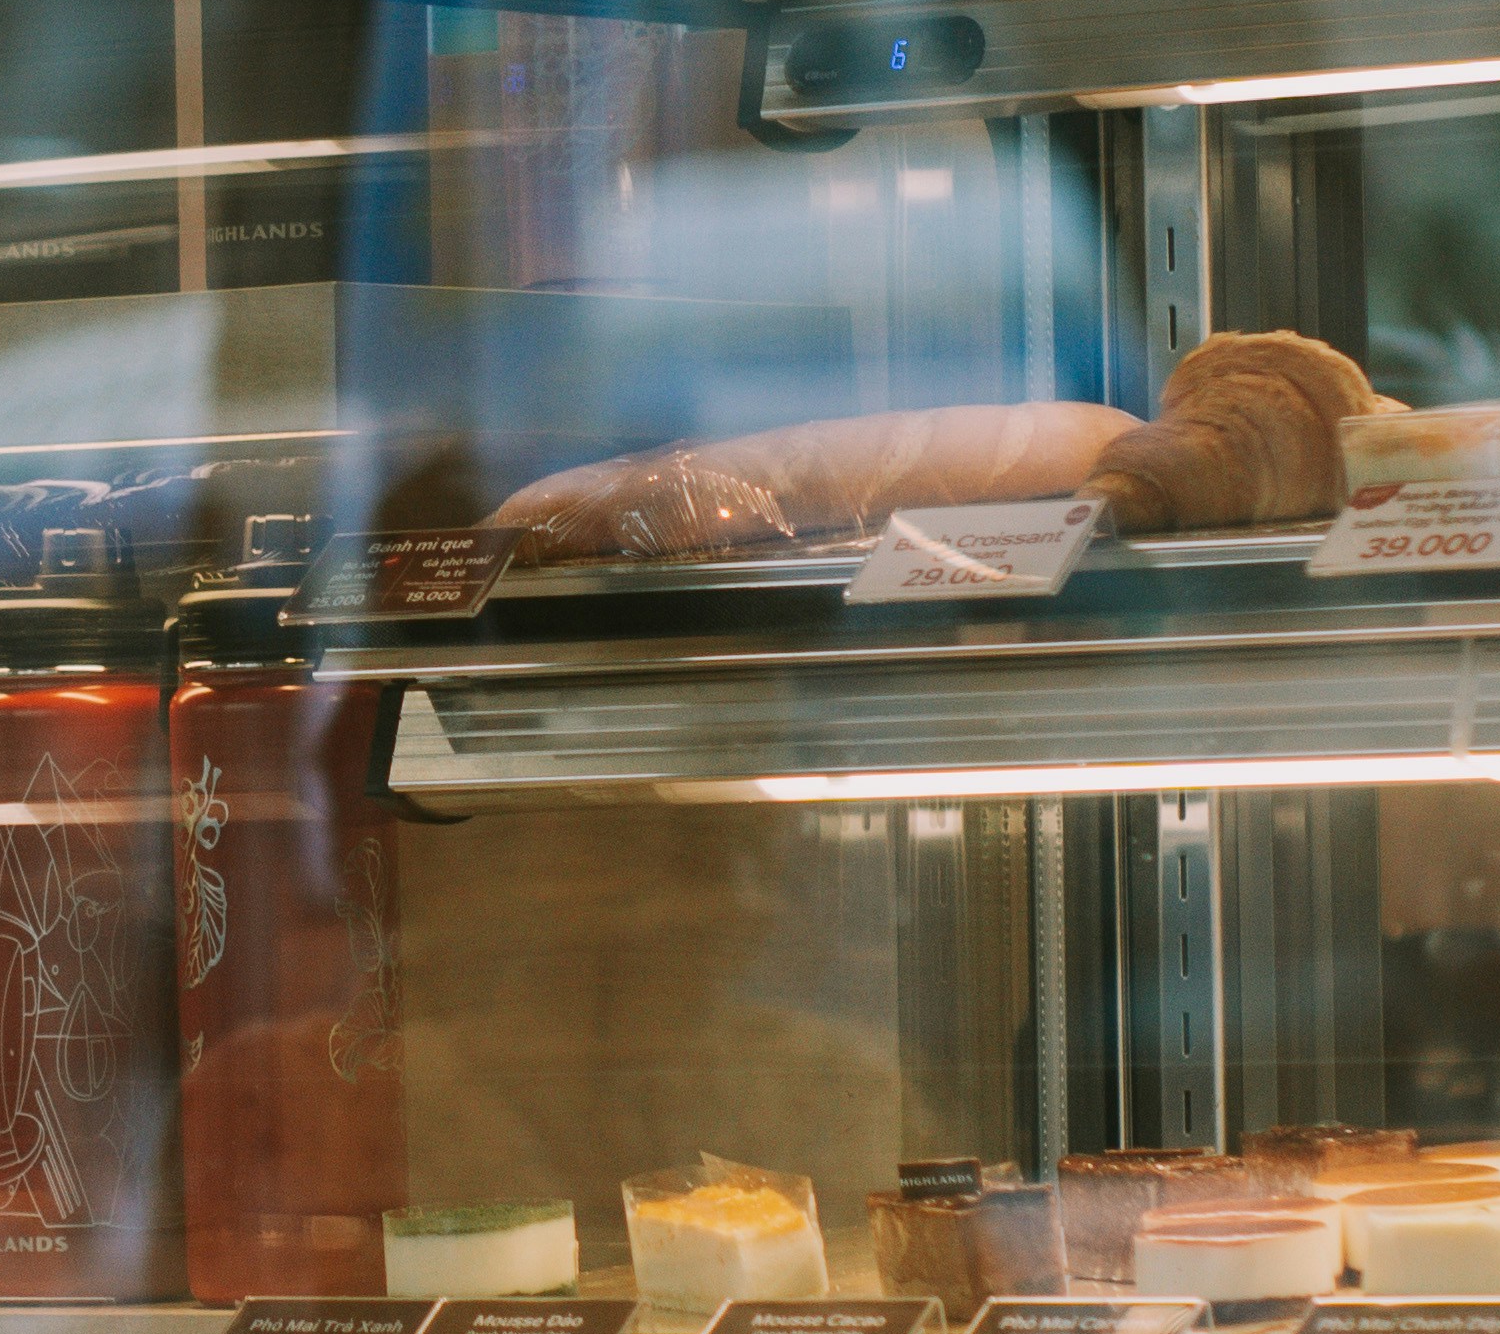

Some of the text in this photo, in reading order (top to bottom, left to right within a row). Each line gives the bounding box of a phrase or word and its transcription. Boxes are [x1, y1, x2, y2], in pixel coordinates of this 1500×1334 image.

[368, 540, 413, 554] Bánh
[441, 539, 474, 553] que
[956, 531, 1065, 548] Croissant
[1358, 531, 1494, 559] 39.000
[406, 590, 461, 603] 19.000
[285, 1318, 320, 1332] Mai
[357, 1319, 404, 1333] Xanh
[473, 1314, 543, 1328] Mousse
[752, 1314, 824, 1327] Mousse
